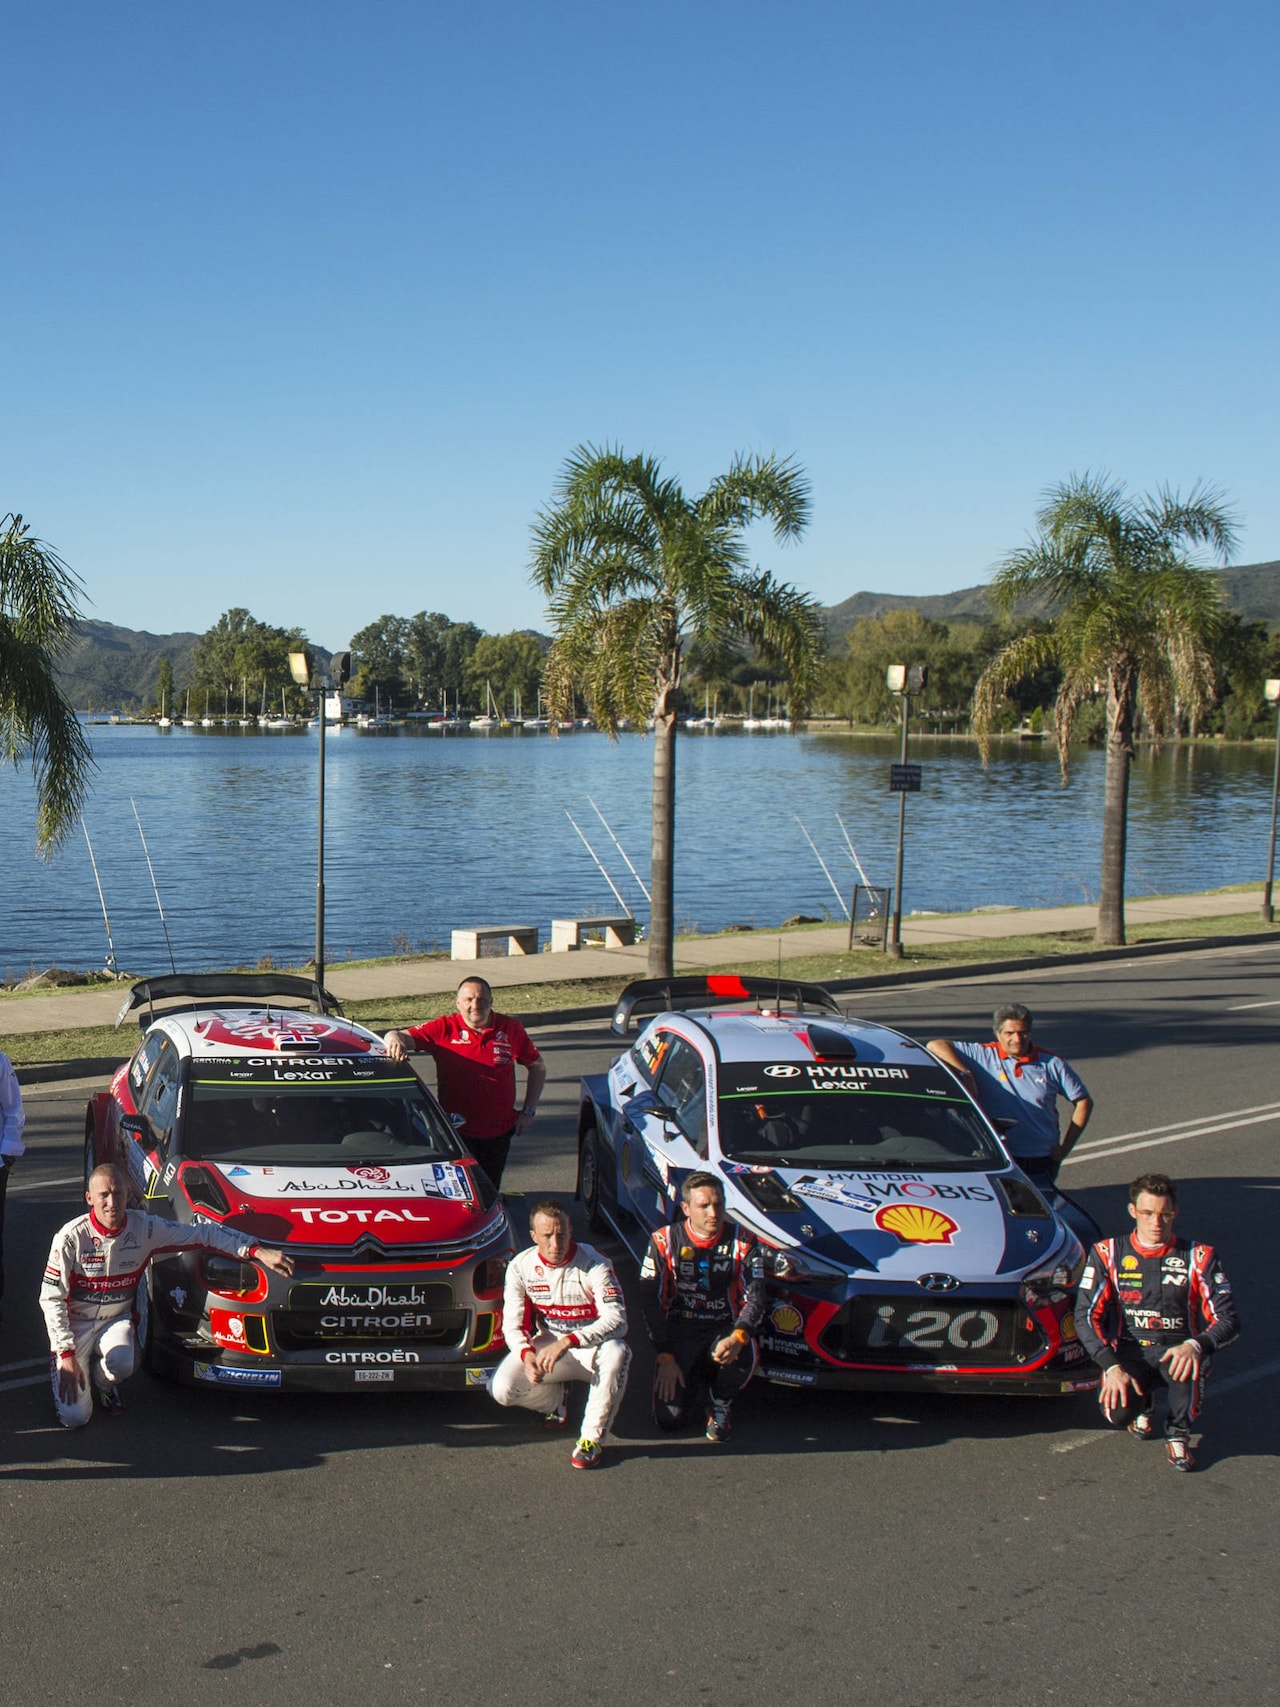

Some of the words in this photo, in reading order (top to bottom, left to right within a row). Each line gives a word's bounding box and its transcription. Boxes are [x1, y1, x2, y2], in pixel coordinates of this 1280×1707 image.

[247, 1056, 354, 1067] CITROËN
[273, 1069, 333, 1081] Lexar
[806, 1065, 910, 1079] HYUNDAI
[811, 1078, 867, 1090] Lexar
[122, 1121, 144, 1131] TOTAL
[826, 1172, 924, 1183] HYUNDAI
[797, 1185, 839, 1200] Argentina
[862, 1182, 995, 1202] MOBIS
[290, 1206, 431, 1224] TOTAL
[320, 1312, 432, 1328] CITROËN
[866, 1304, 1000, 1349] i20
[1133, 1315, 1184, 1331] MOBIS
[325, 1349, 420, 1364] CITROËN
[217, 1370, 279, 1382] MICHELIN
[767, 1369, 814, 1382] MICHELIN
